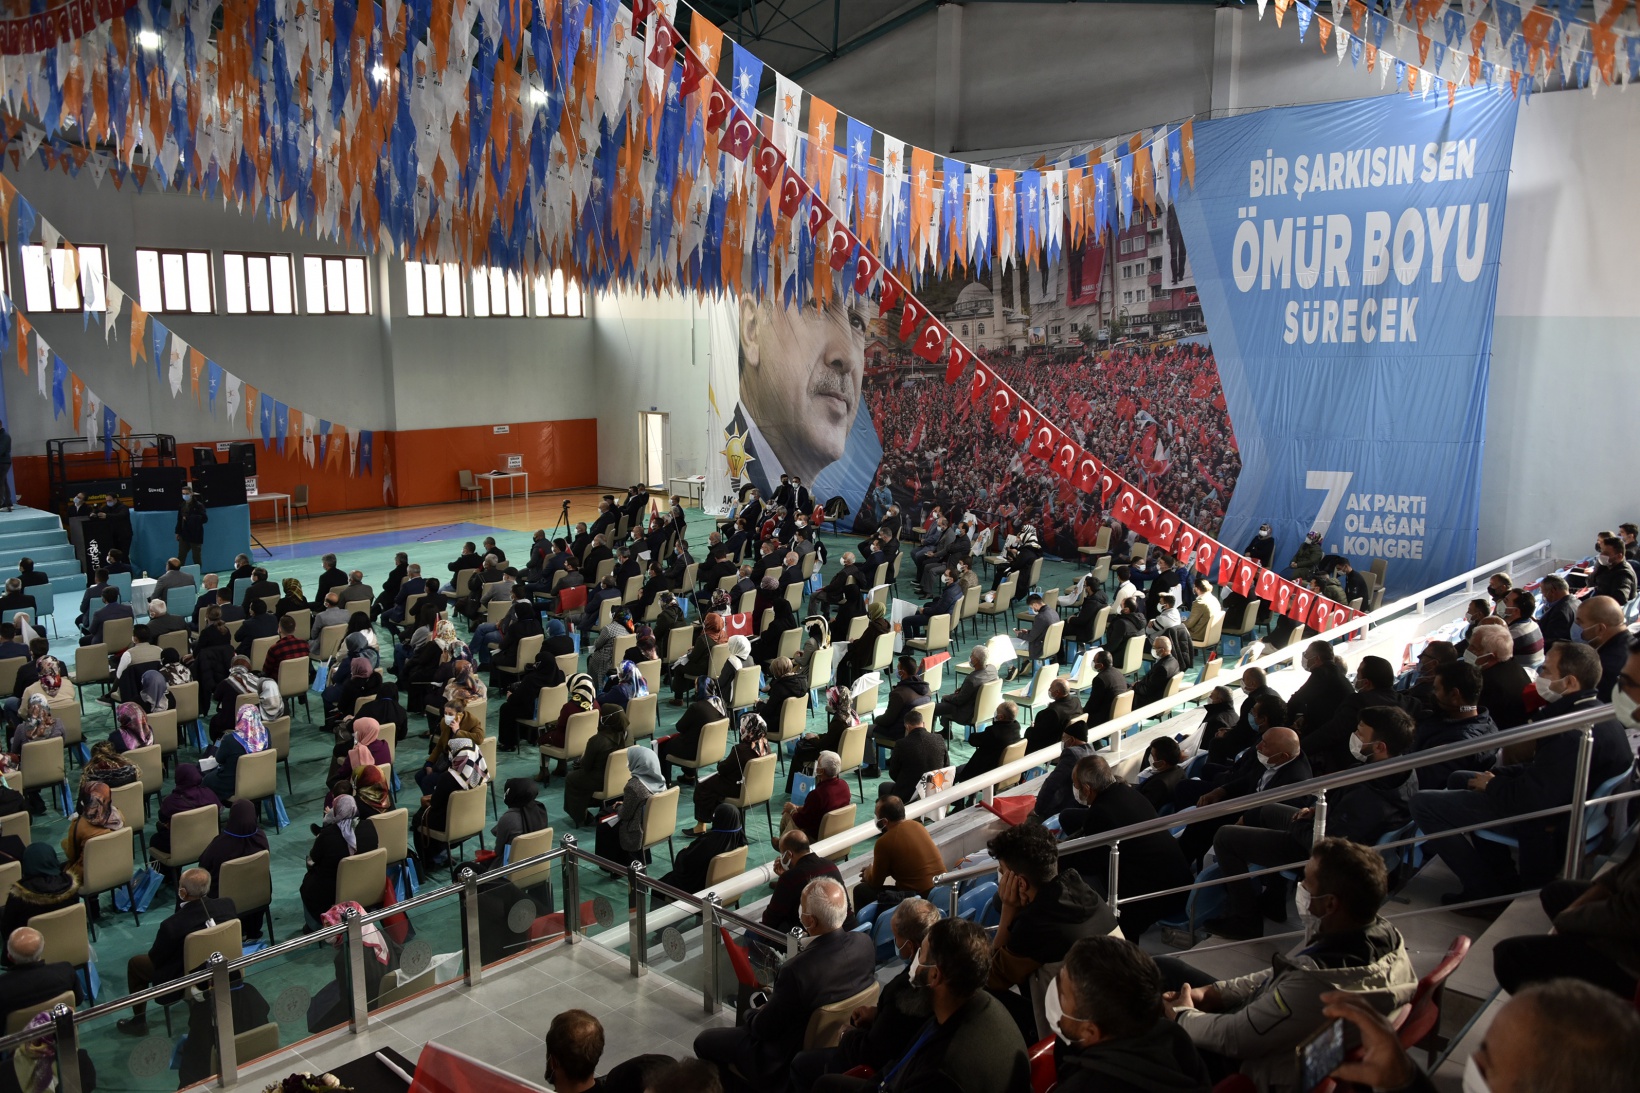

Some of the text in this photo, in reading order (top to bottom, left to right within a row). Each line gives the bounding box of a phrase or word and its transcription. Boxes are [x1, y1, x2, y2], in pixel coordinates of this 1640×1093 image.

[1250, 139, 1477, 202] BİR ŞARKISIN SEN
[1232, 203, 1489, 292] ÖMÜR BOYU
[1283, 297, 1419, 344] SÜRECEK
[1346, 493, 1426, 514] AK PARTİ
[1344, 513, 1425, 536] OLAĞAN
[1343, 535, 1423, 560] KONGRE
